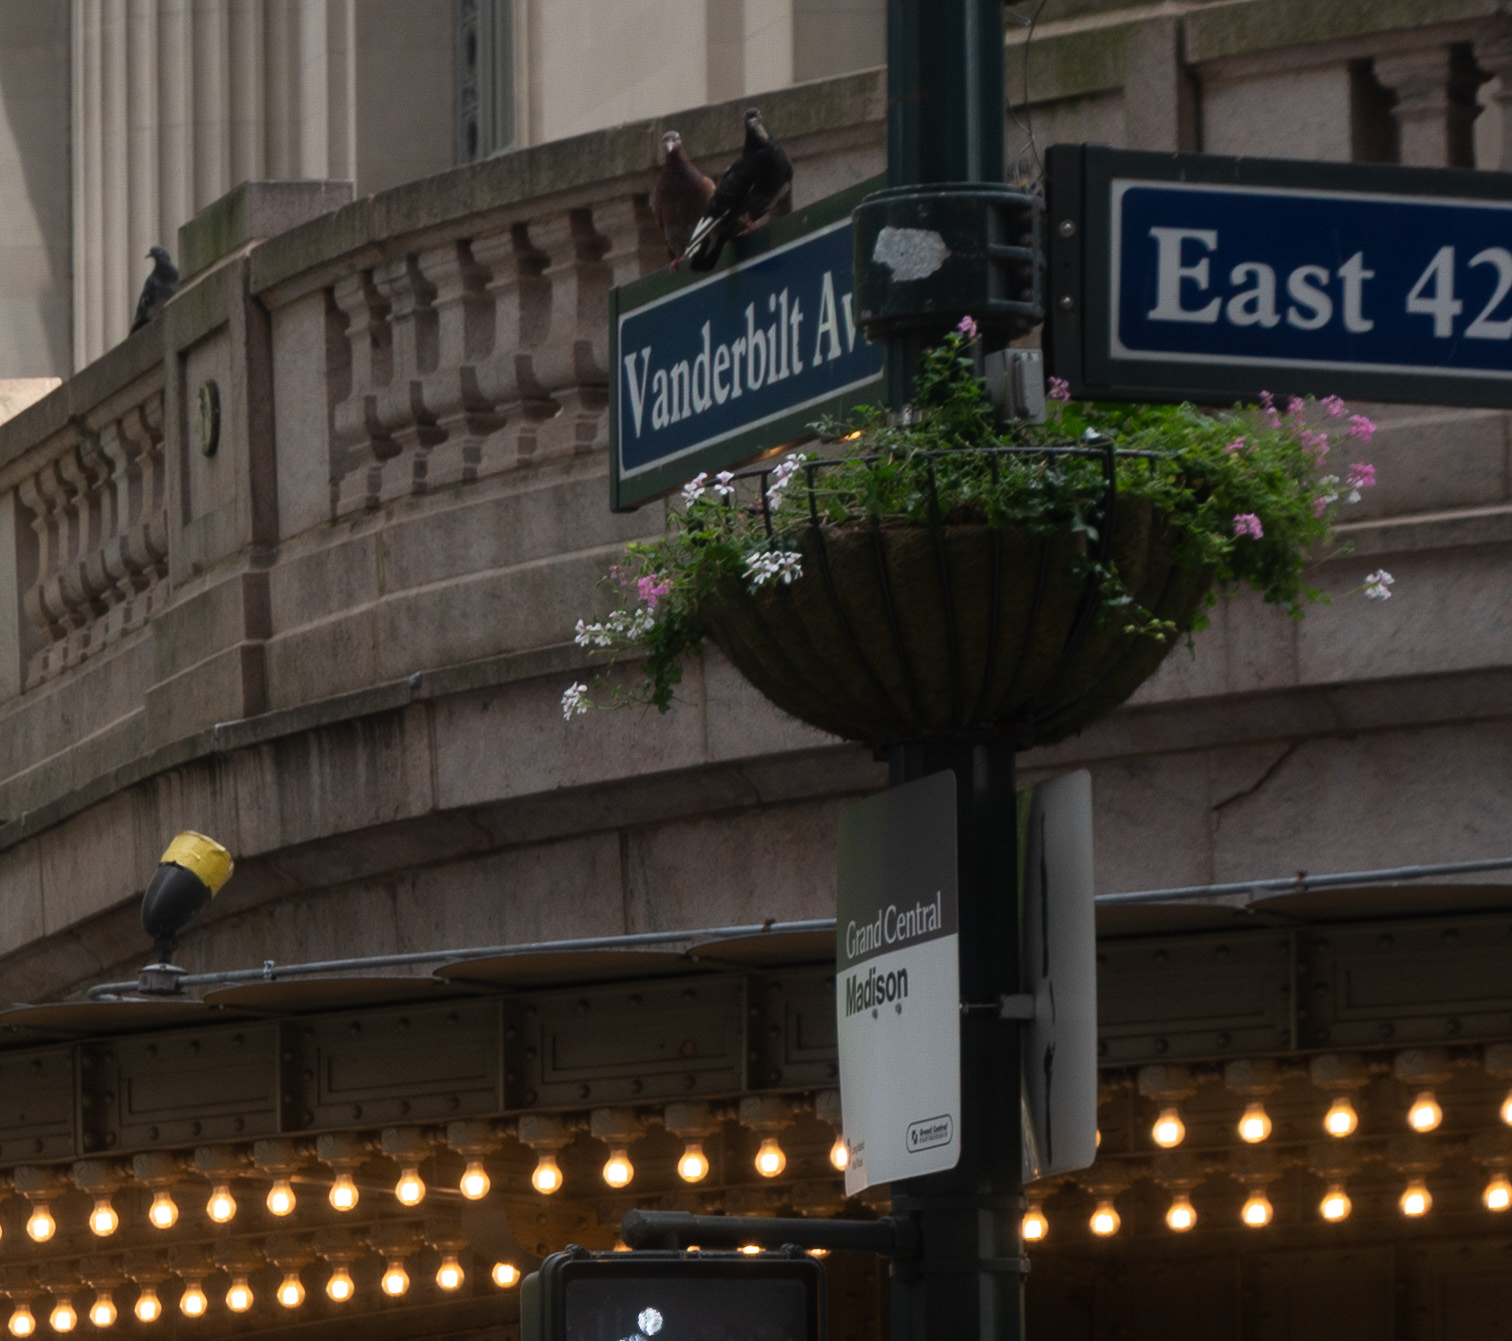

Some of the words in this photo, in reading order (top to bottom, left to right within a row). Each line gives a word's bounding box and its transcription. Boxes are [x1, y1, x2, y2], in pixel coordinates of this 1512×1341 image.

[1147, 226, 1375, 333] East
[1405, 245, 1512, 340] 42
[624, 287, 804, 439] Vanderbilt
[813, 271, 872, 367] Av
[846, 909, 882, 959] Grand
[884, 890, 941, 944] Central
[846, 966, 908, 1017] Madison
